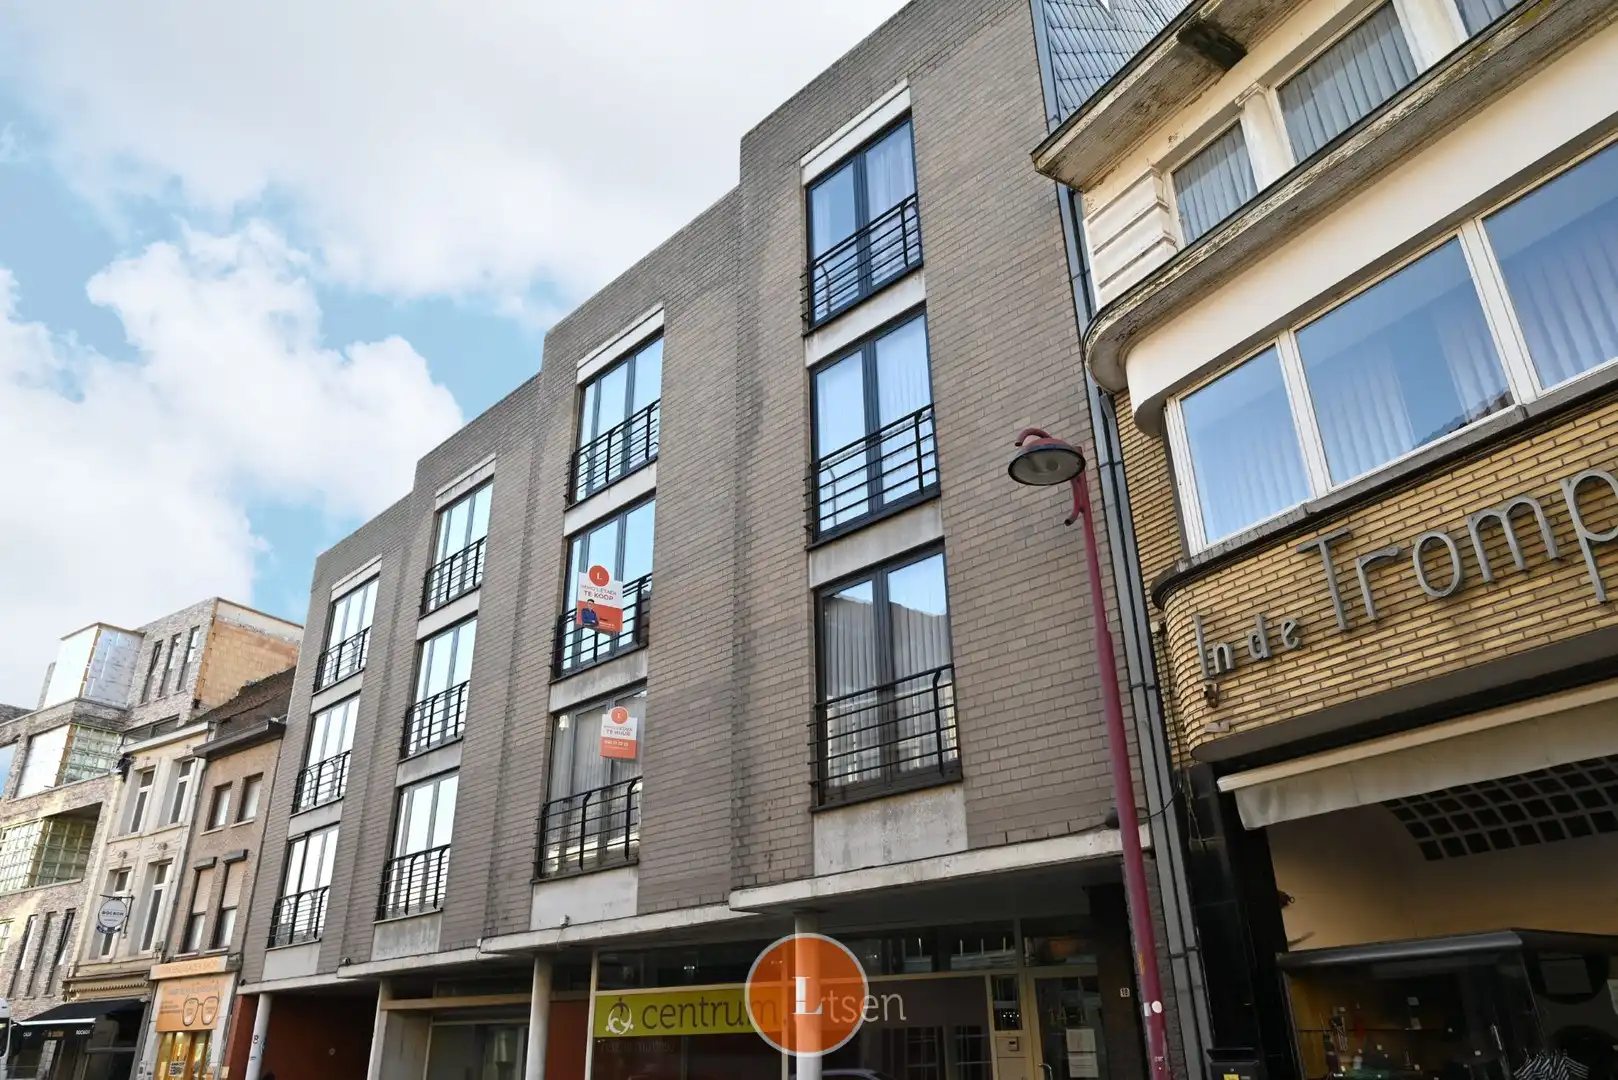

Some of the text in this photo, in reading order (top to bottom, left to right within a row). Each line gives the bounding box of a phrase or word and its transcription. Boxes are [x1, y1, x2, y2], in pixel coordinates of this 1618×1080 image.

[1195, 470, 1618, 680] In de Tromp
[594, 592, 614, 601] KOOP
[642, 990, 907, 1030] centrum tsen
